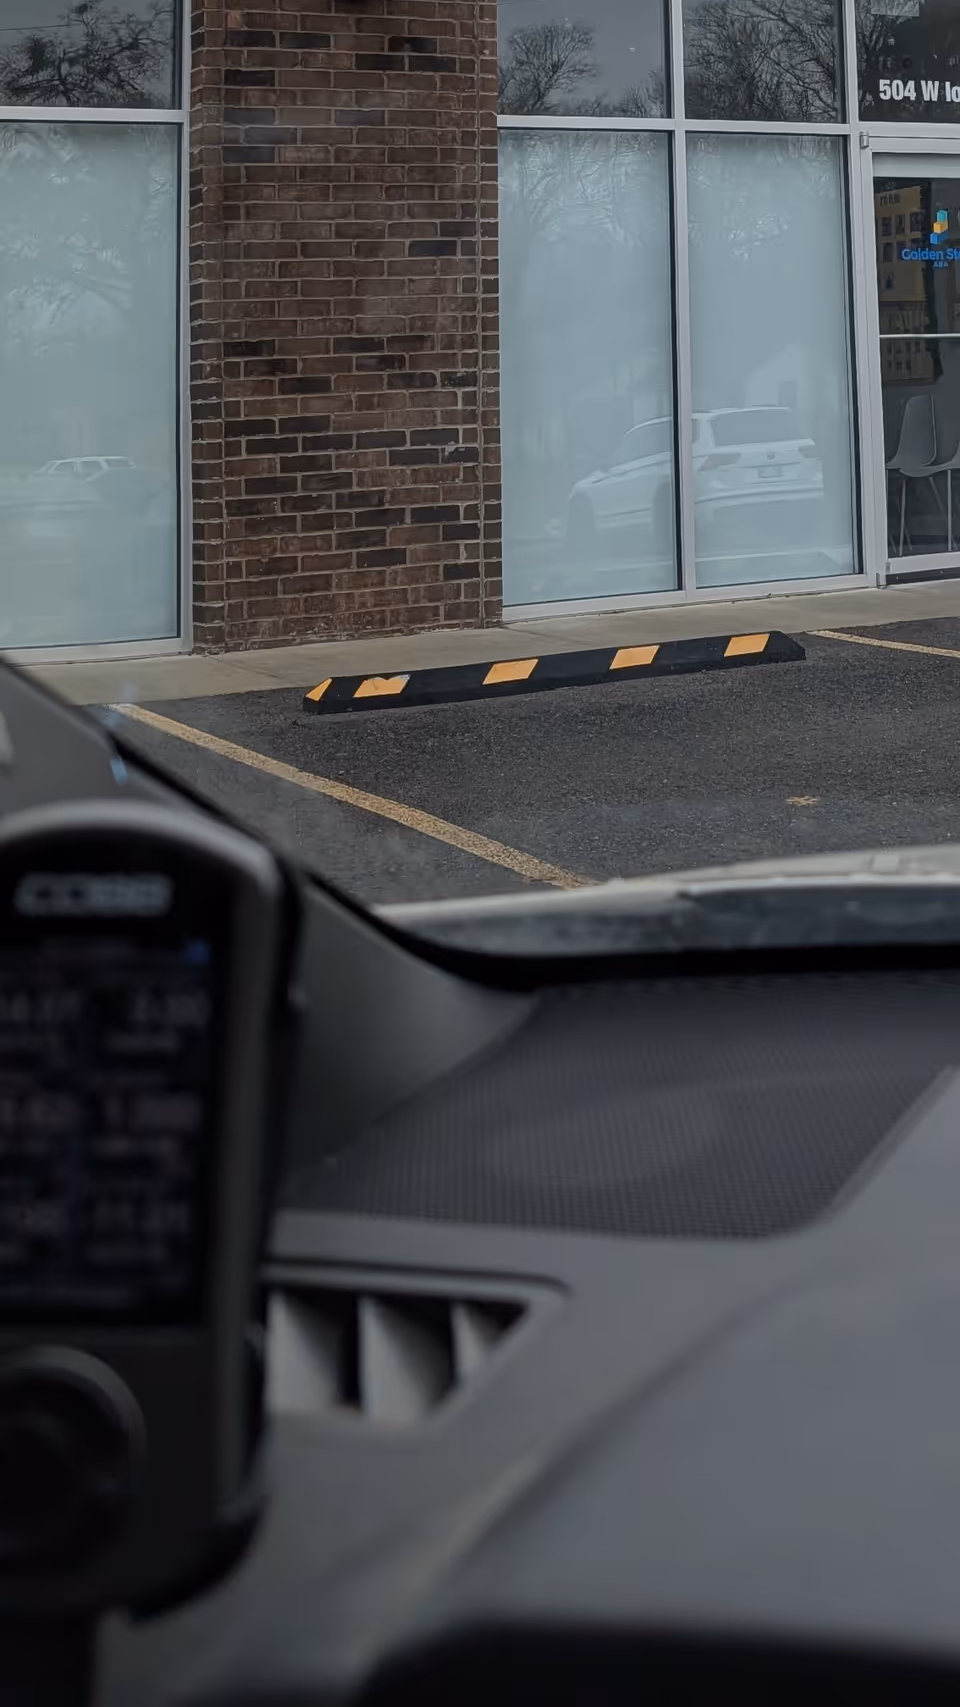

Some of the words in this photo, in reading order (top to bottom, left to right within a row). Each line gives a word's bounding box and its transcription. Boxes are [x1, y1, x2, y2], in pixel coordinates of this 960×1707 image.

[879, 79, 916, 100] 504
[920, 80, 939, 101] W
[901, 247, 944, 261] Golden
